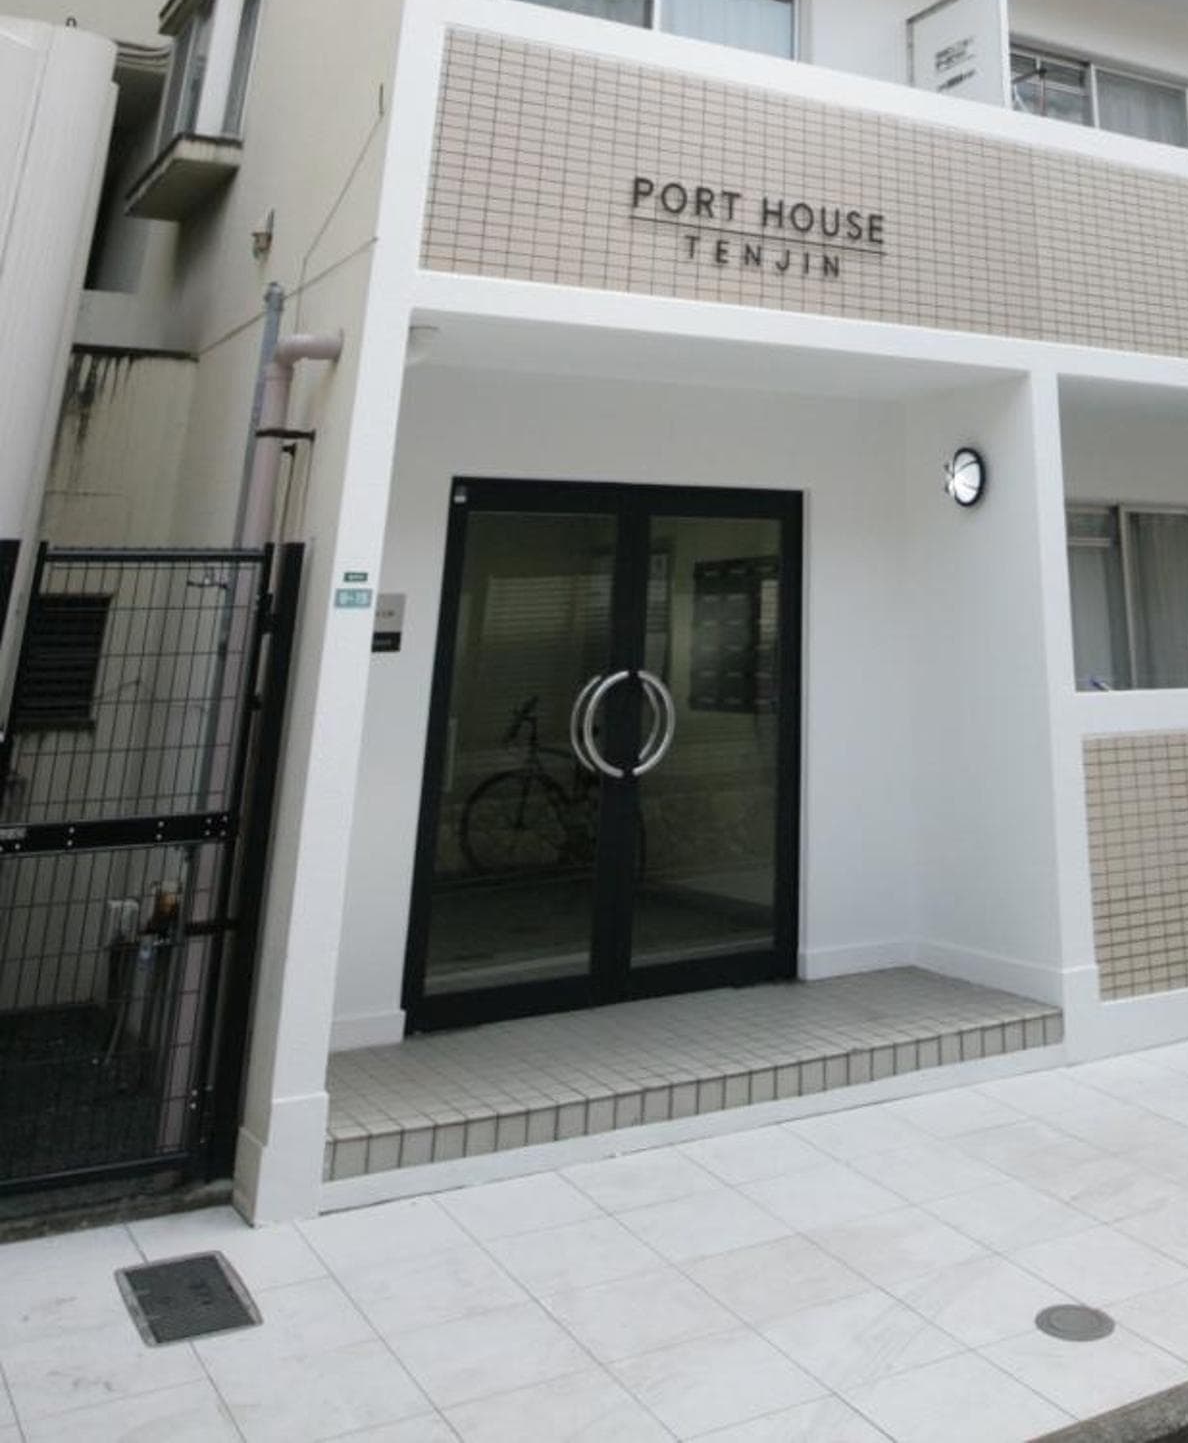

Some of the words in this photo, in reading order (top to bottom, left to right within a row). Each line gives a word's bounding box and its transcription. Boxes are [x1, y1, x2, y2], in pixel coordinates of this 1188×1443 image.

[632, 176, 742, 221] PORT
[761, 197, 885, 244] HOUSE
[684, 235, 840, 278] TENJIN
